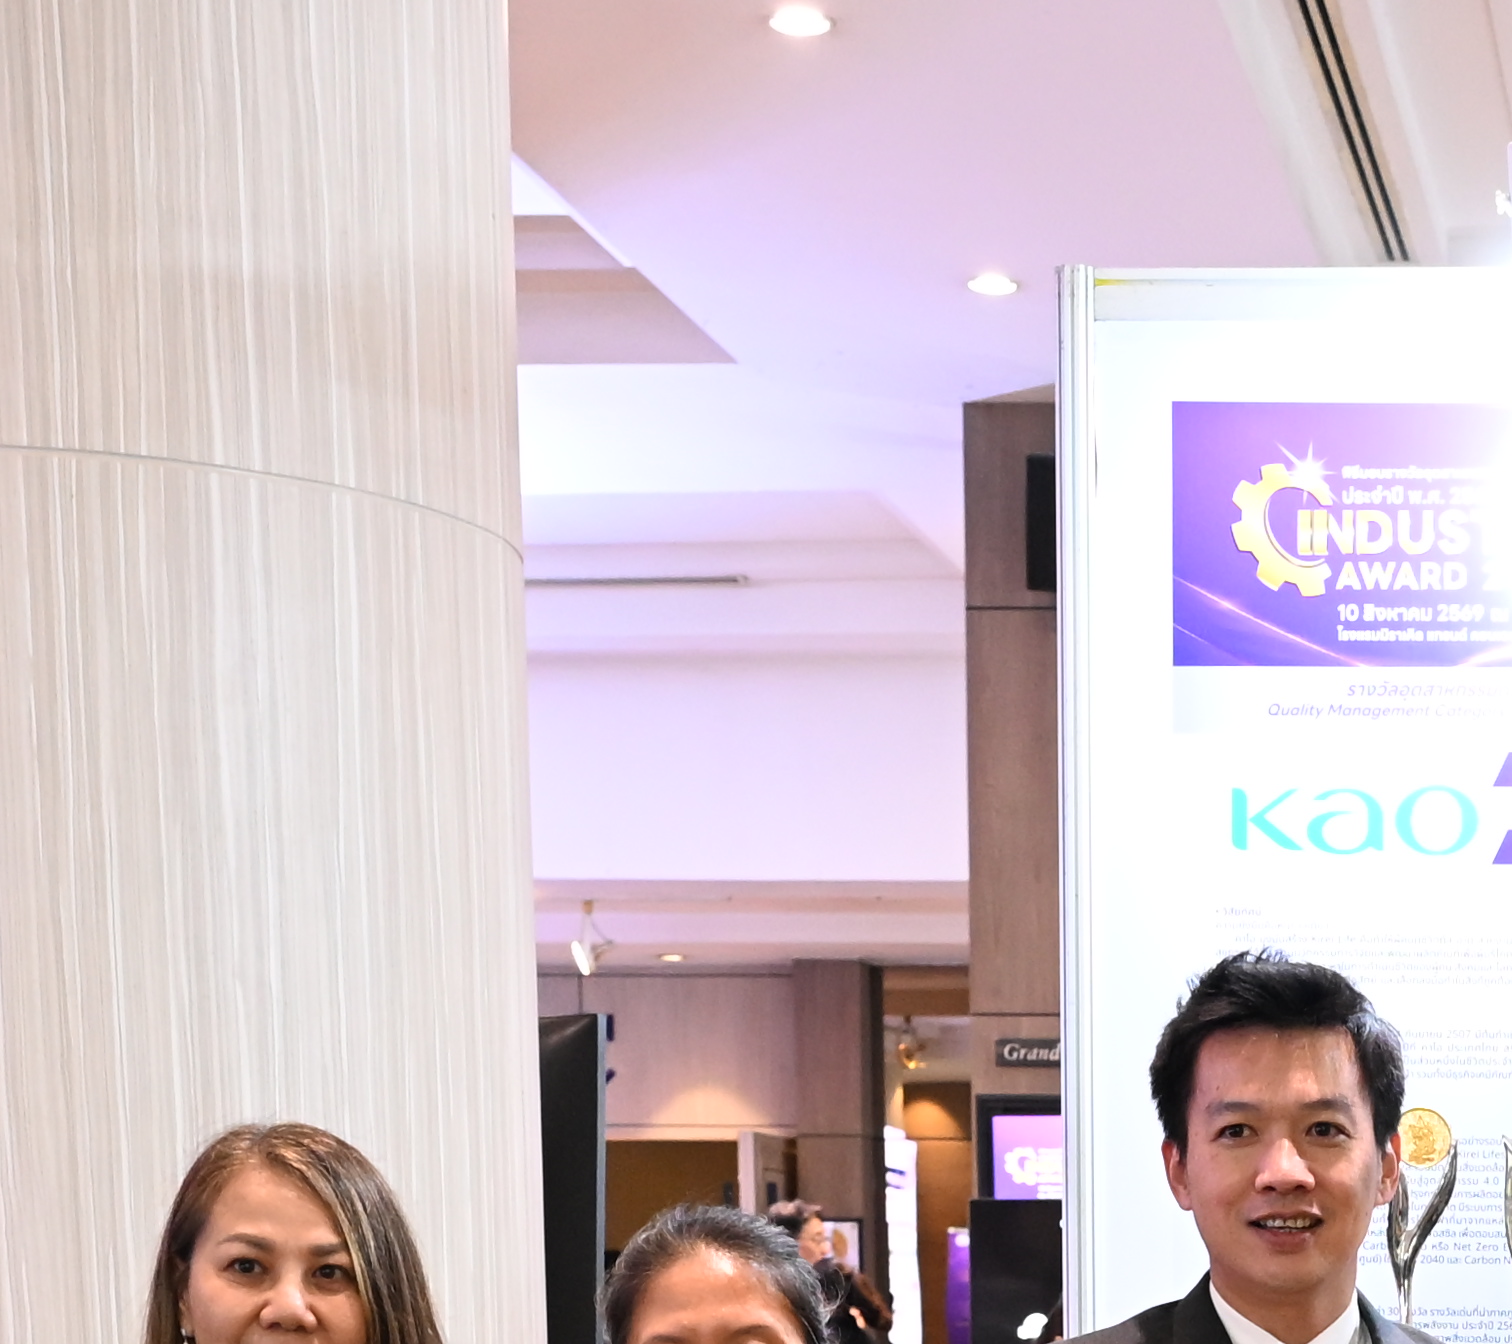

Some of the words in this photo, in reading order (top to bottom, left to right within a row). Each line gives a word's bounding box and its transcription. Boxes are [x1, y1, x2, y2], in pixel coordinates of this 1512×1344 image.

[1337, 561, 1467, 592] AWARD
[1337, 603, 1359, 622] 10
[1437, 603, 1484, 622] 2569
[1268, 704, 1323, 719] Quality
[1328, 704, 1429, 720] Management
[1230, 784, 1480, 856] kao
[1003, 1043, 1060, 1062] Grand
